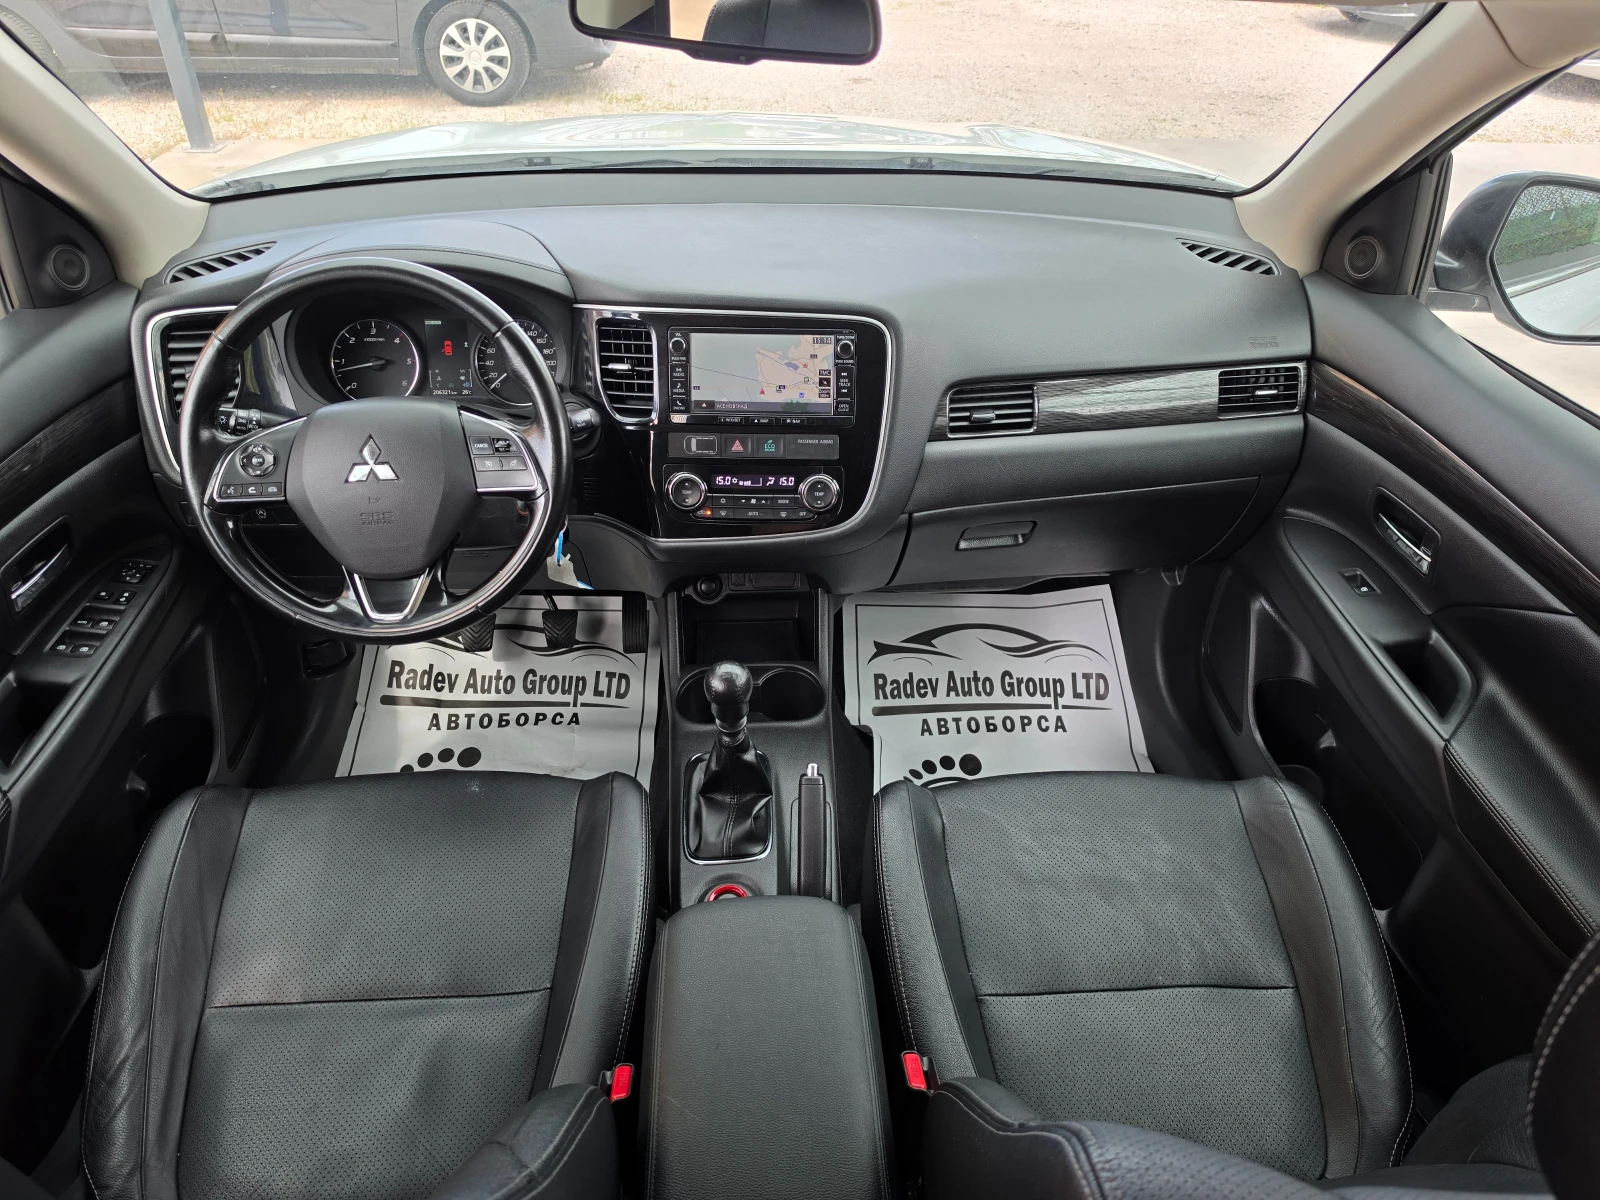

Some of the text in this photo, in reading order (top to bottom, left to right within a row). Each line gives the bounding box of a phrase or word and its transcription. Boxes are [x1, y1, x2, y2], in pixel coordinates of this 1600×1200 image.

[716, 476, 731, 485] 15.0
[779, 476, 795, 486] 15.0
[387, 659, 631, 708] Radev Auto Group LTD
[873, 670, 1110, 710] Radev Auto Group LTD
[427, 712, 581, 731] АВТОБОРСА
[920, 715, 1067, 737] АВТОБОРСА
